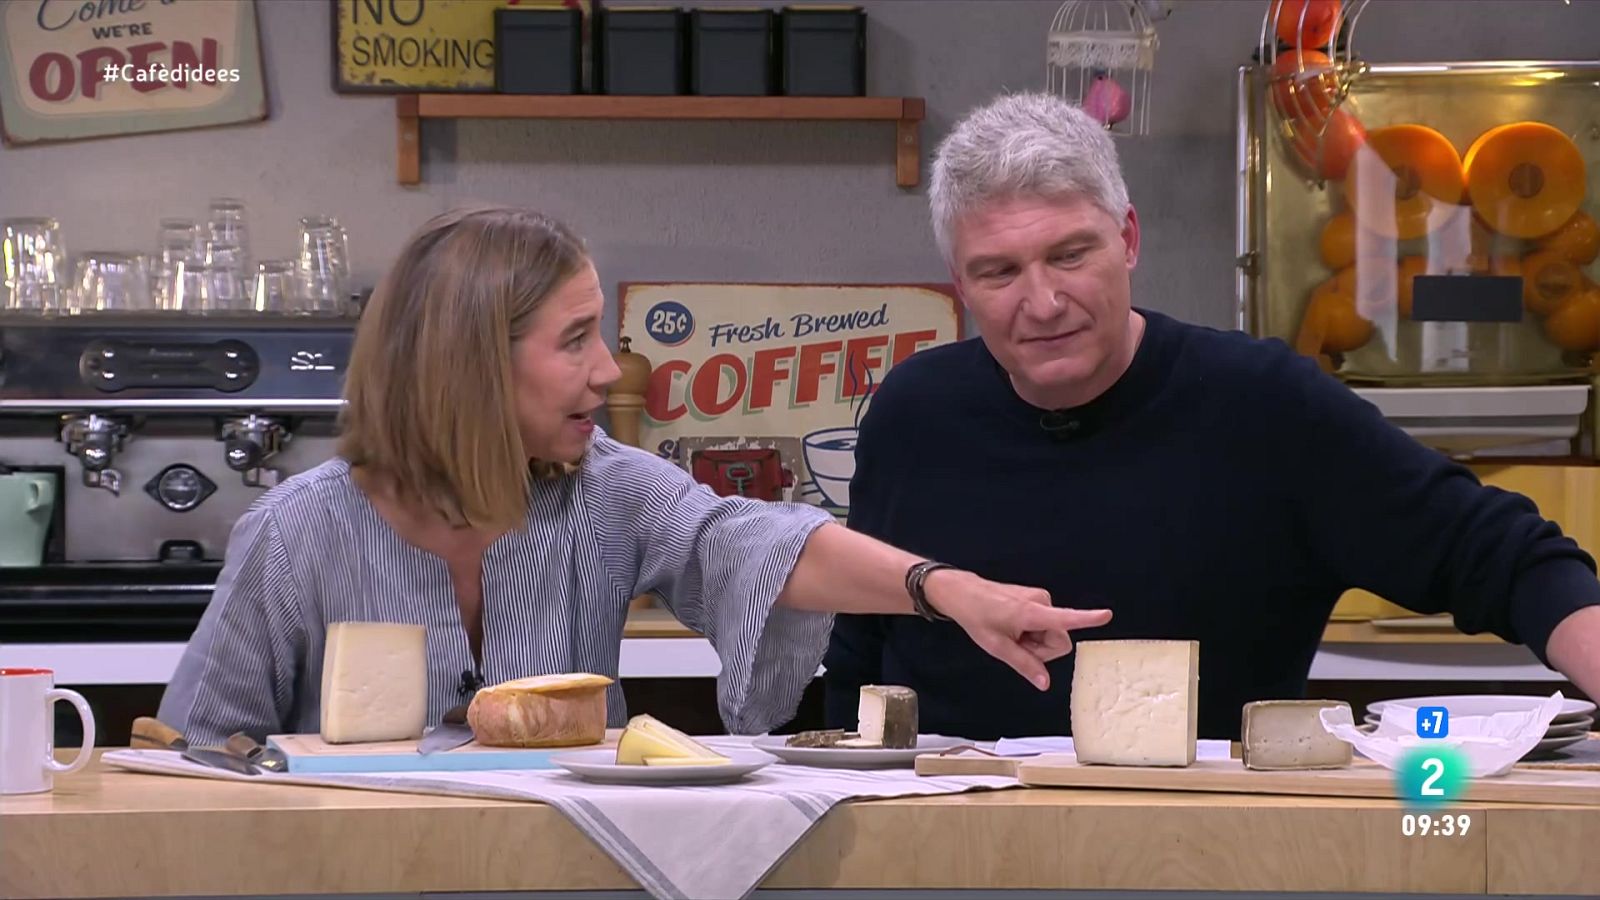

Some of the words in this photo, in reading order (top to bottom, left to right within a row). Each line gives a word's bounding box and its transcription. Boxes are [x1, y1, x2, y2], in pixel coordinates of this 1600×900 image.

[352, 0, 425, 26] NO
[92, 22, 153, 40] WE'RE
[351, 36, 494, 69] SMOKING
[29, 38, 218, 102] OPEN
[651, 309, 687, 335] 25¢
[709, 317, 785, 347] Fresh
[790, 303, 889, 337] Brewed
